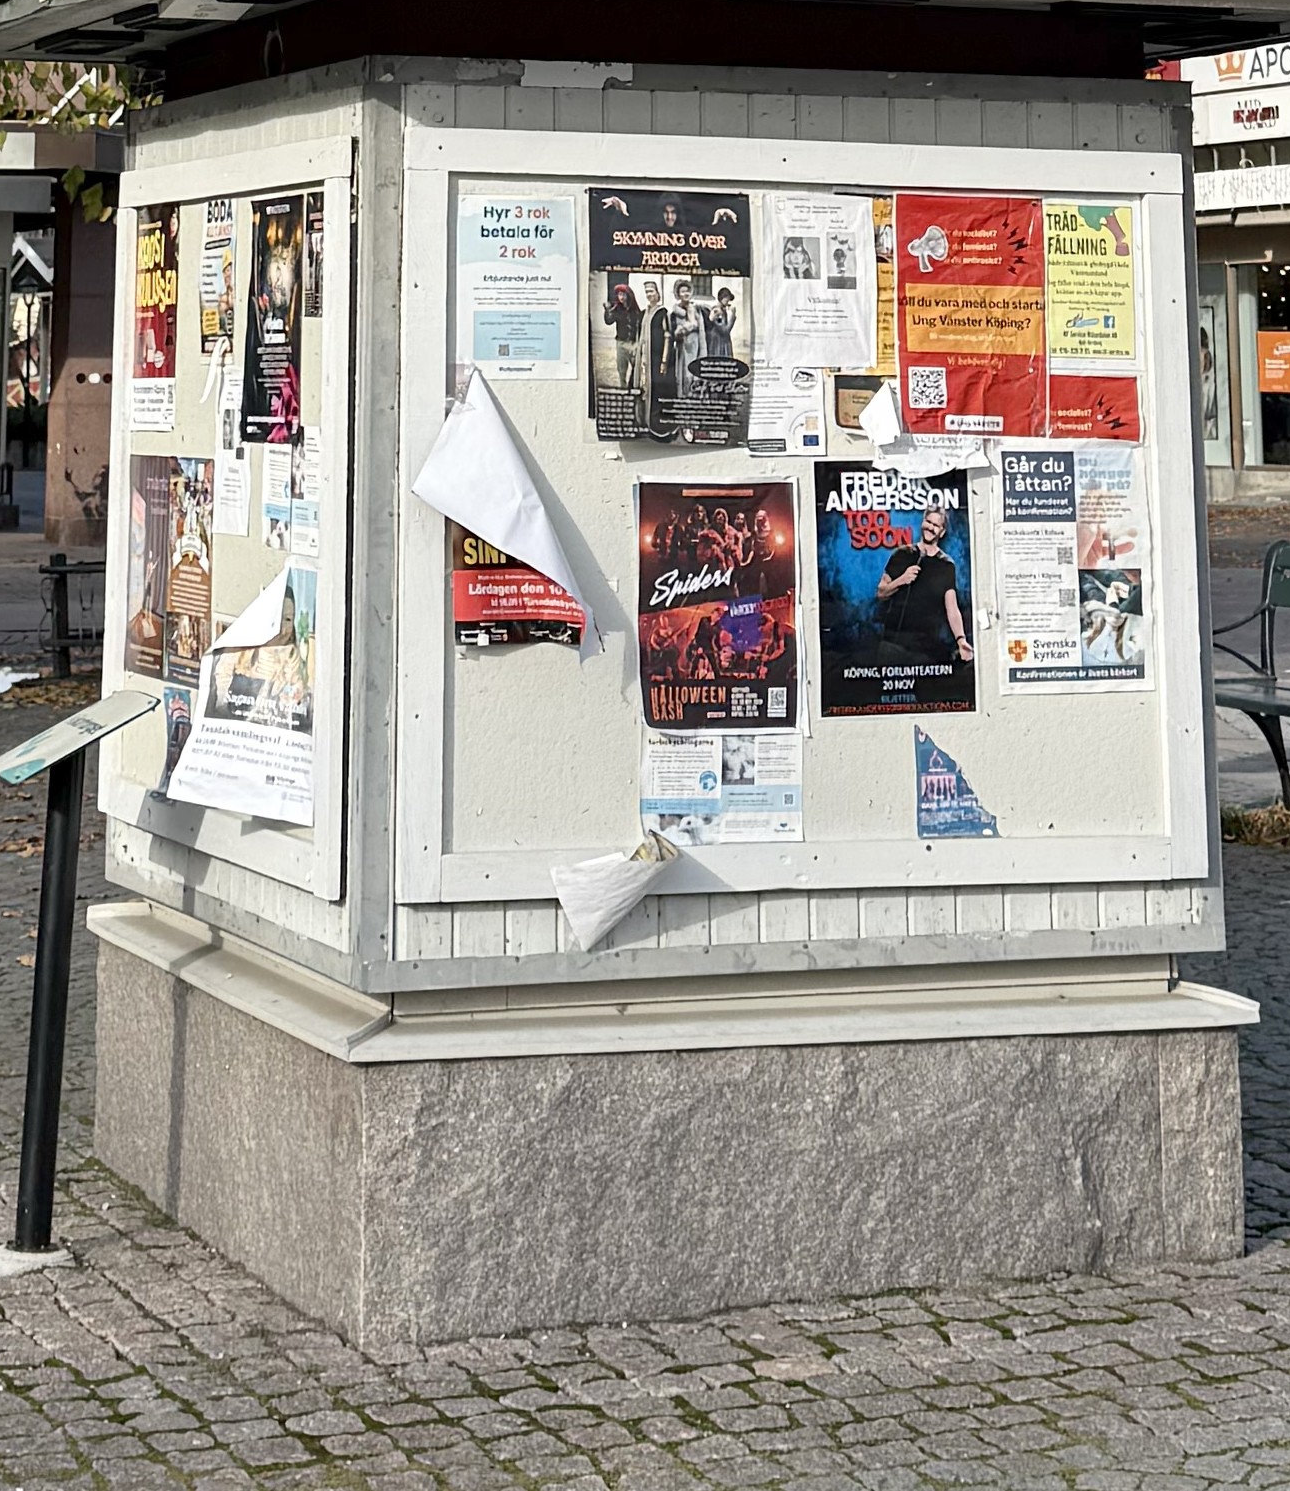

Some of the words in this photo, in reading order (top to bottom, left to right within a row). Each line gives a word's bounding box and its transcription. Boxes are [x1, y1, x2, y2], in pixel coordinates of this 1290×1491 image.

[483, 206, 511, 223] Hyr
[515, 205, 523, 219] 3
[528, 206, 551, 219] rok
[481, 225, 531, 238] betala
[534, 225, 555, 238] för
[612, 231, 685, 247] SKYMNING
[689, 232, 727, 249] ÖVER
[1048, 234, 1107, 256] FÄLLNING
[499, 245, 508, 258] 2
[512, 245, 536, 258] rok
[641, 251, 701, 266] ARBOGA
[917, 297, 932, 307] du
[934, 300, 960, 308] vara
[961, 299, 986, 309] med
[988, 299, 1010, 309] och
[912, 314, 937, 327] Ung
[939, 314, 984, 327] Vänster
[985, 317, 1031, 330] Köping?
[1004, 455, 1037, 473] Går
[1041, 457, 1065, 473] du
[1005, 475, 1010, 492] i
[1014, 474, 1072, 492] åttan?
[825, 488, 960, 512] ANDERSSON
[1021, 498, 1032, 506] du
[842, 510, 890, 530] TOO
[1005, 507, 1016, 517] på
[851, 527, 913, 549] SOON
[468, 583, 517, 596] Lördagen
[521, 582, 544, 593] den
[649, 563, 735, 607] Spiders
[1033, 638, 1077, 649] Svenska
[1033, 649, 1070, 662] kyrkan
[883, 680, 893, 691] 20
[894, 679, 915, 690] NOV
[651, 684, 726, 705] HALLOWEEN
